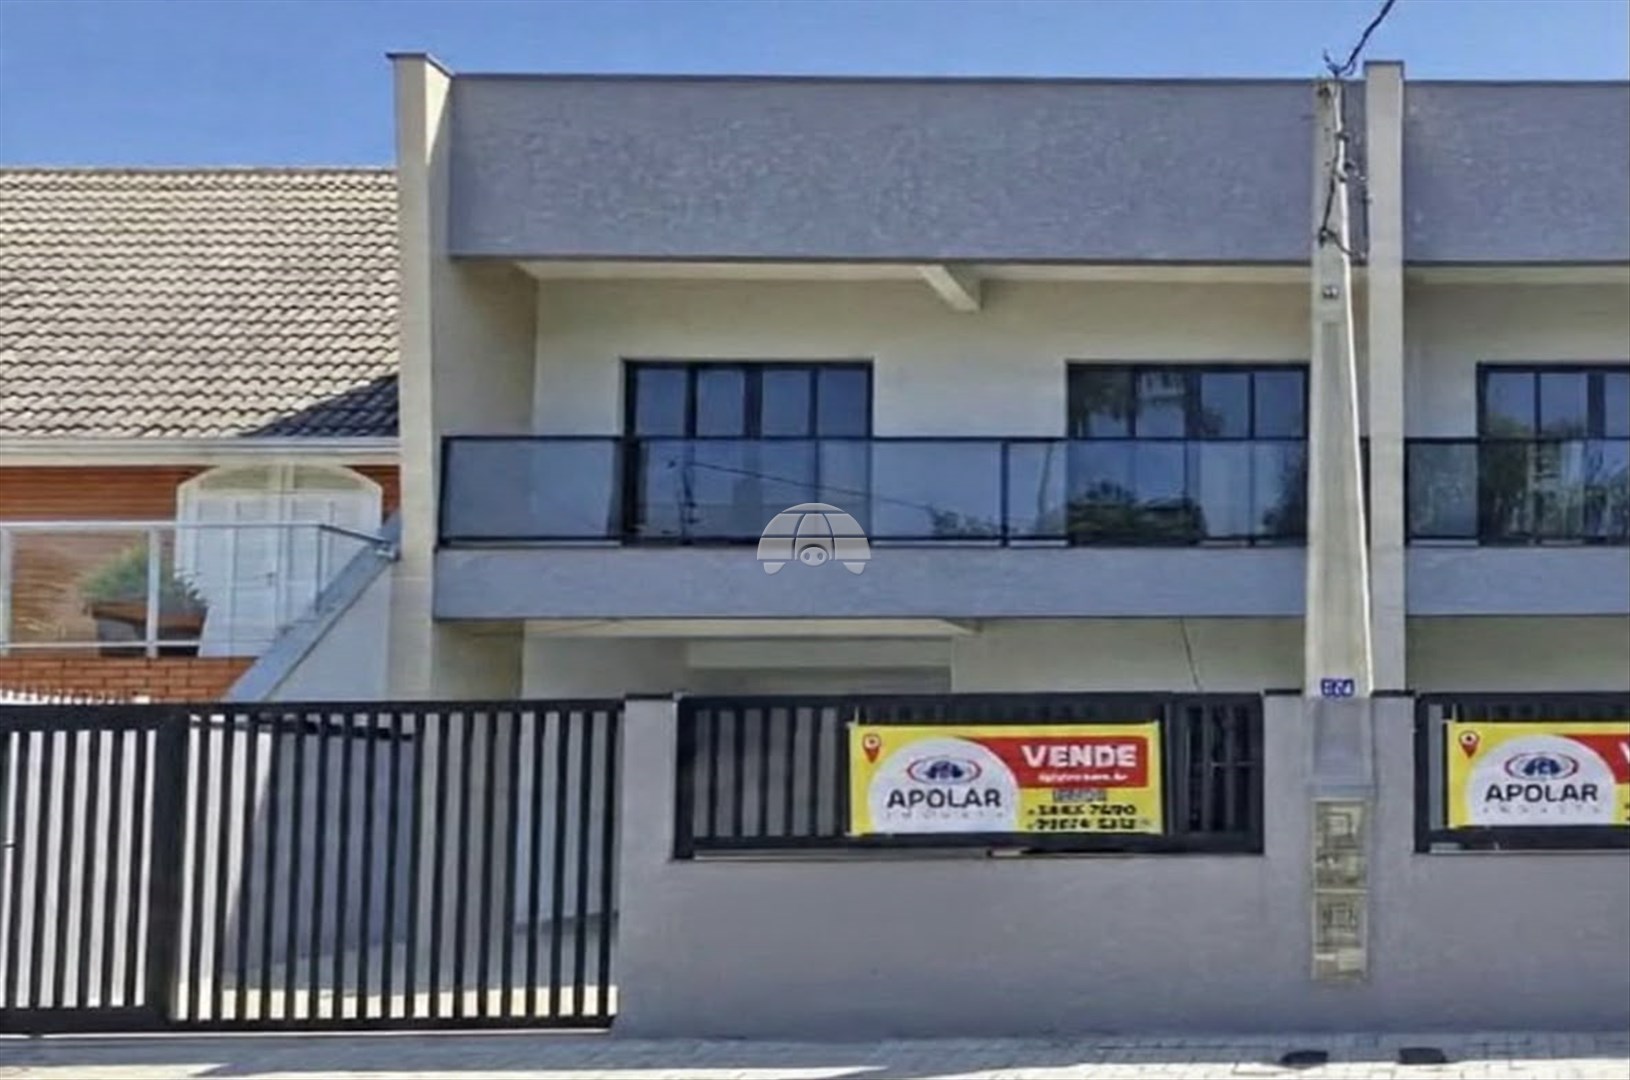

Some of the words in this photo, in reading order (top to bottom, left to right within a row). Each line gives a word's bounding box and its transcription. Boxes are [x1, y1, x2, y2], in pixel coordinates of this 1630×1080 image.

[1021, 744, 1137, 768] VENDE
[886, 787, 1002, 809] APOLAR
[1484, 783, 1599, 803] APOLAR
